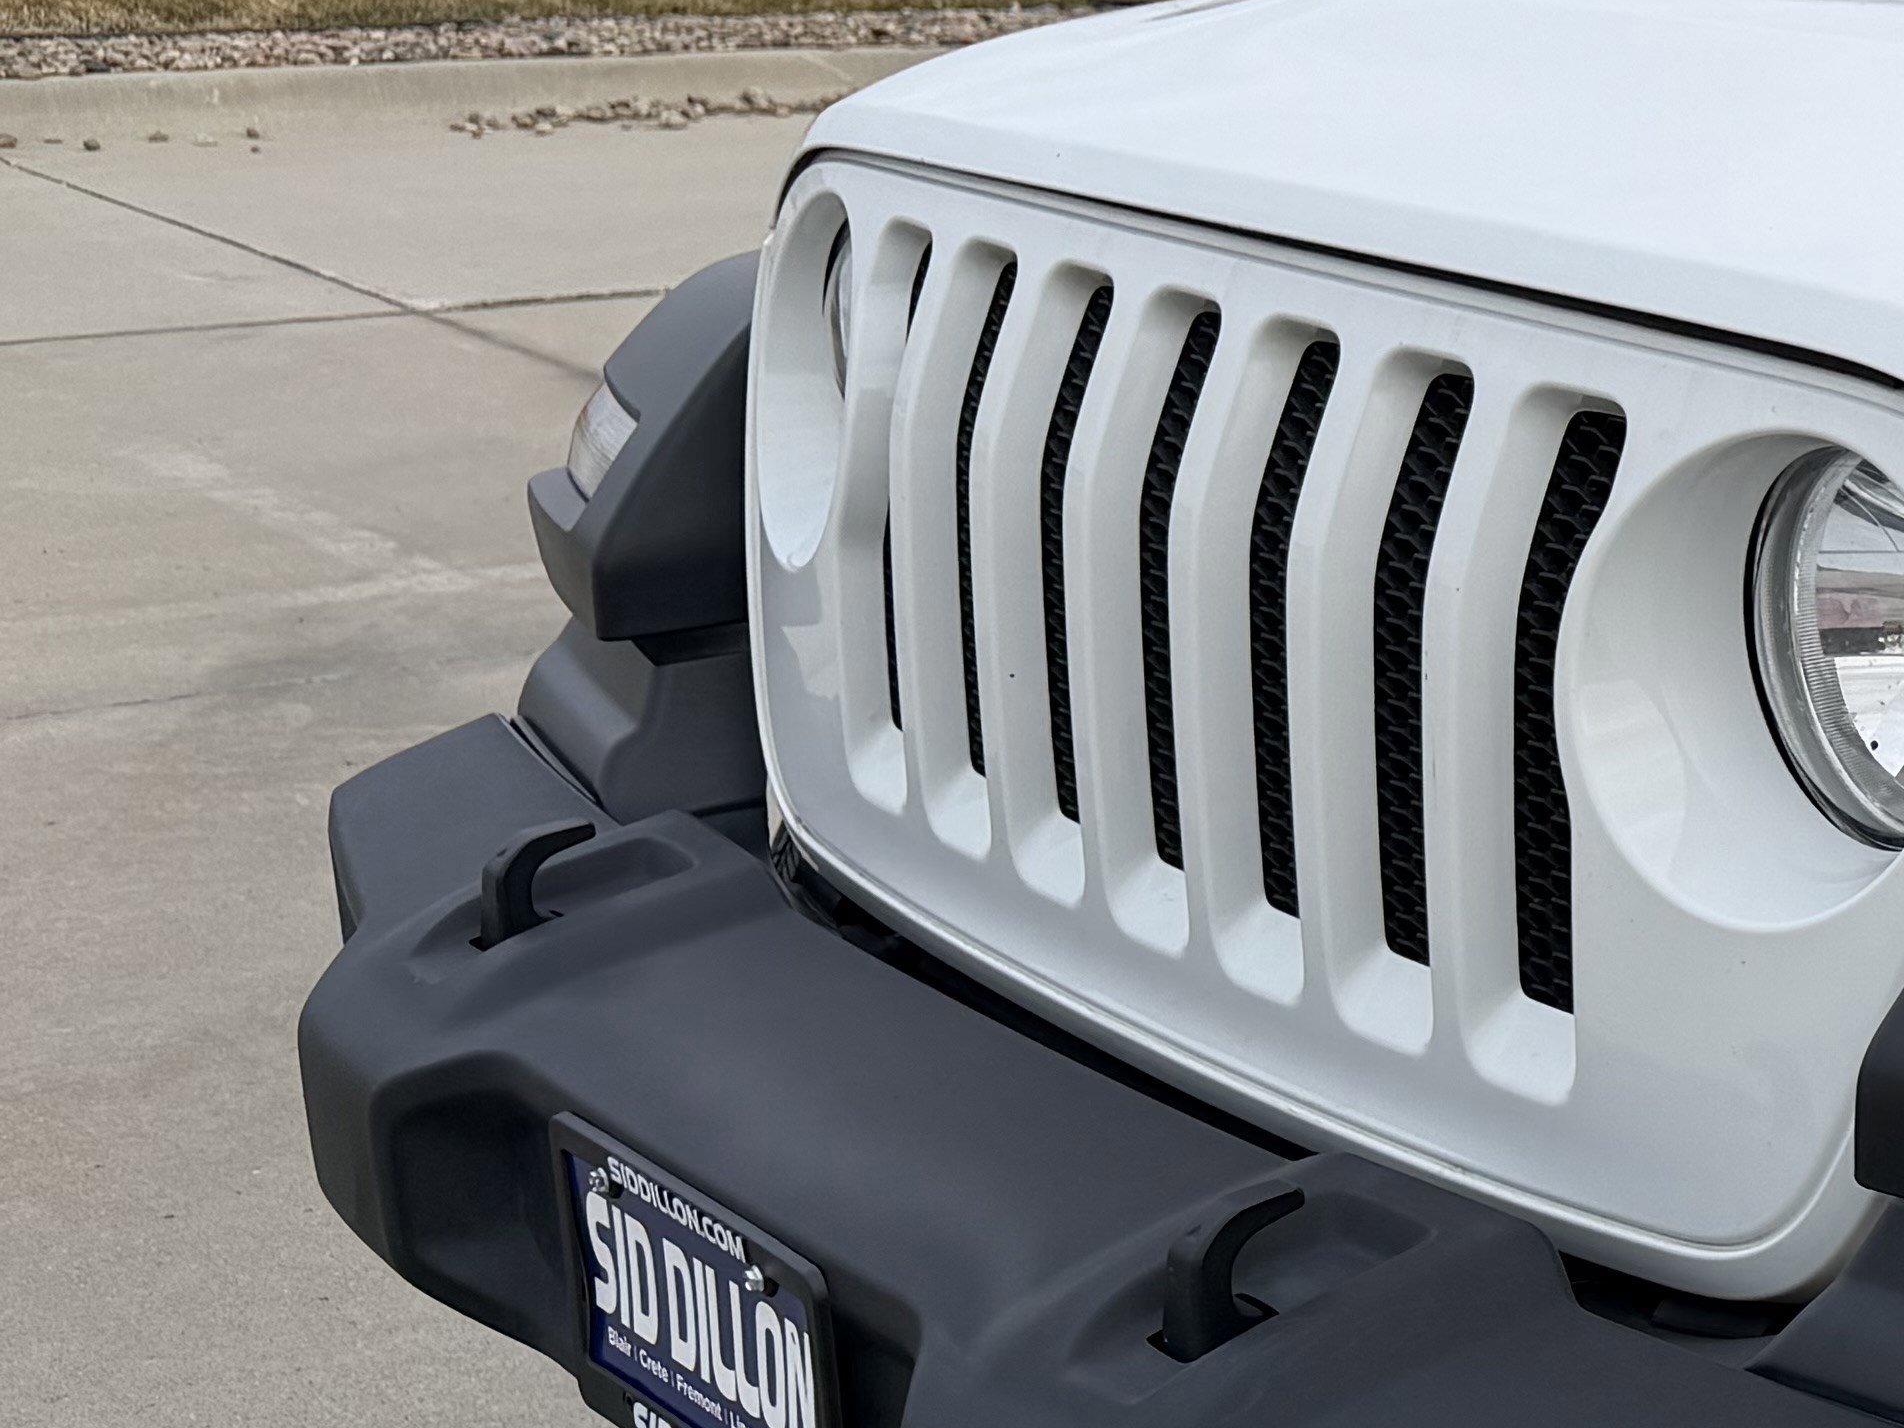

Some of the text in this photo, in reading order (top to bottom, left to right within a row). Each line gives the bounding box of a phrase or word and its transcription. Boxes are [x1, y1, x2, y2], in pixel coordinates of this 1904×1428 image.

[606, 1156, 748, 1263] SIDDILLON.COM
[585, 1191, 659, 1346] SID
[606, 1324, 632, 1358] Blair
[639, 1346, 669, 1385] Crete
[676, 1372, 723, 1421] Fremont
